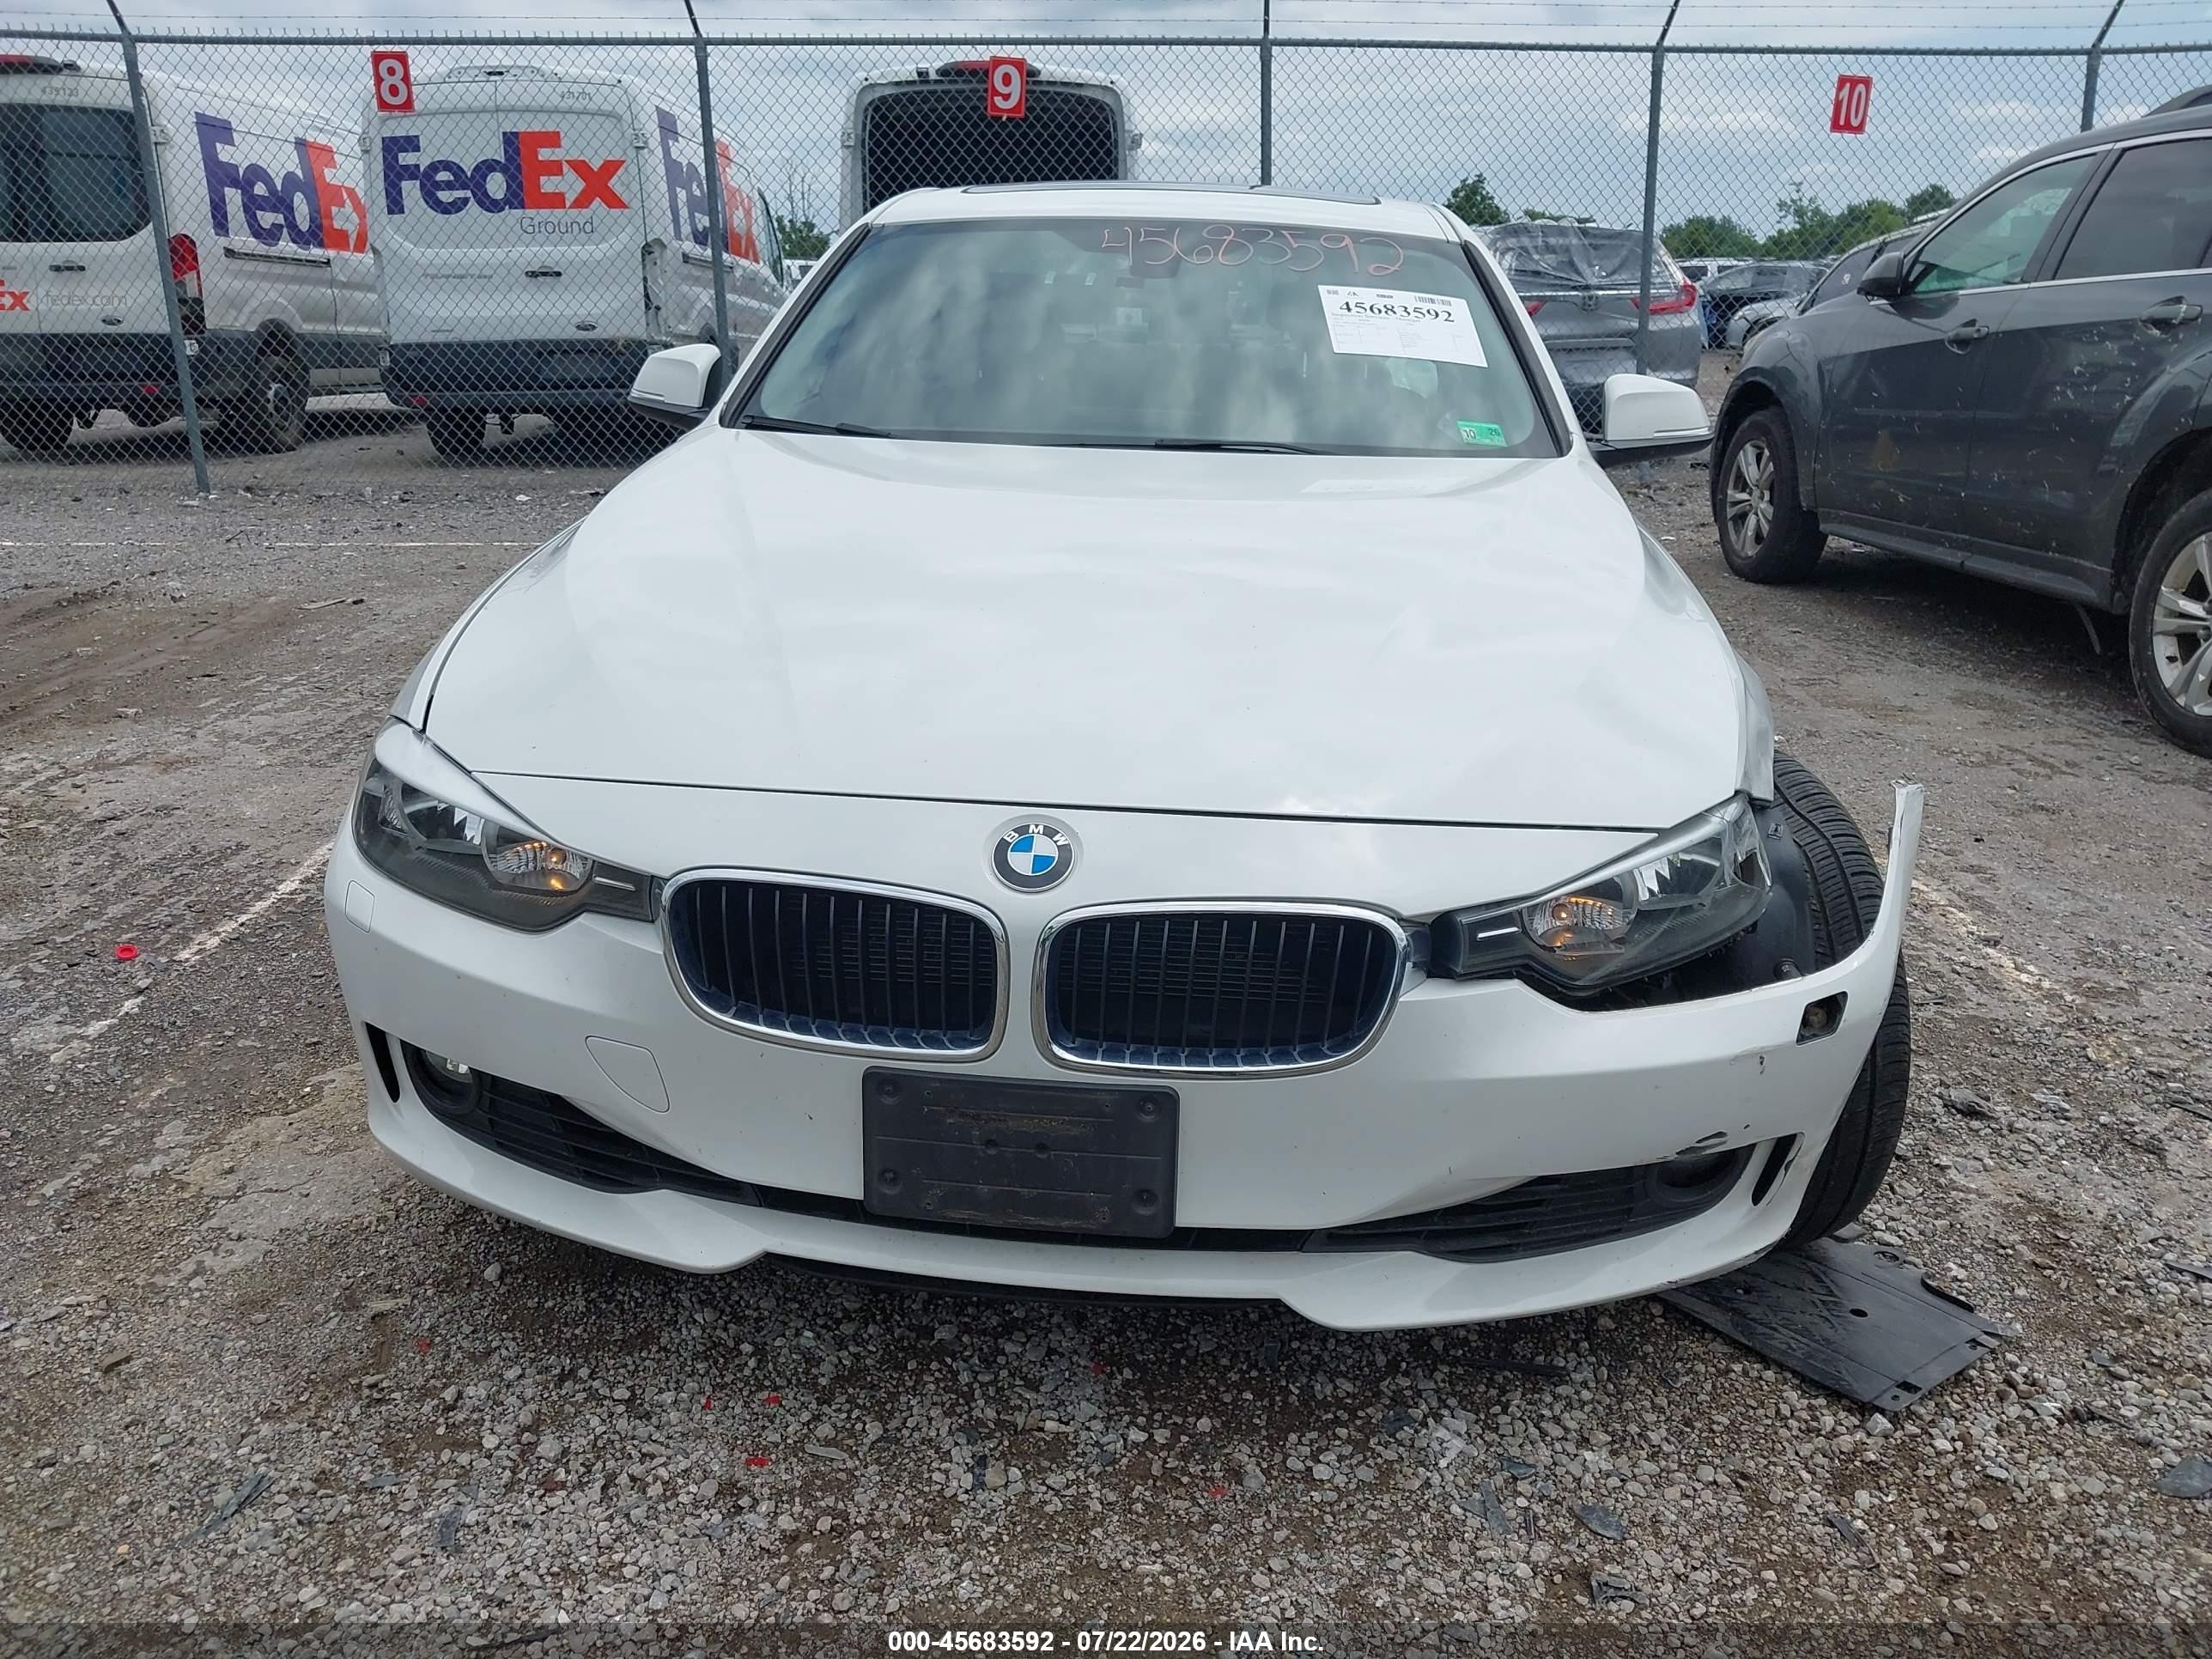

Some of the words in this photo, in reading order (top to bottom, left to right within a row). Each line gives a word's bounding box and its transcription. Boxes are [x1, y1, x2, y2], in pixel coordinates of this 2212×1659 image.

[378, 58, 408, 106] 8
[993, 64, 1022, 110] 9
[1838, 82, 1867, 128] 10
[381, 131, 630, 216] FedEx
[520, 216, 594, 234] Ground
[1100, 224, 1405, 276] 45683592
[1339, 301, 1455, 324] 45683592
[1002, 823, 1069, 846] BMW
